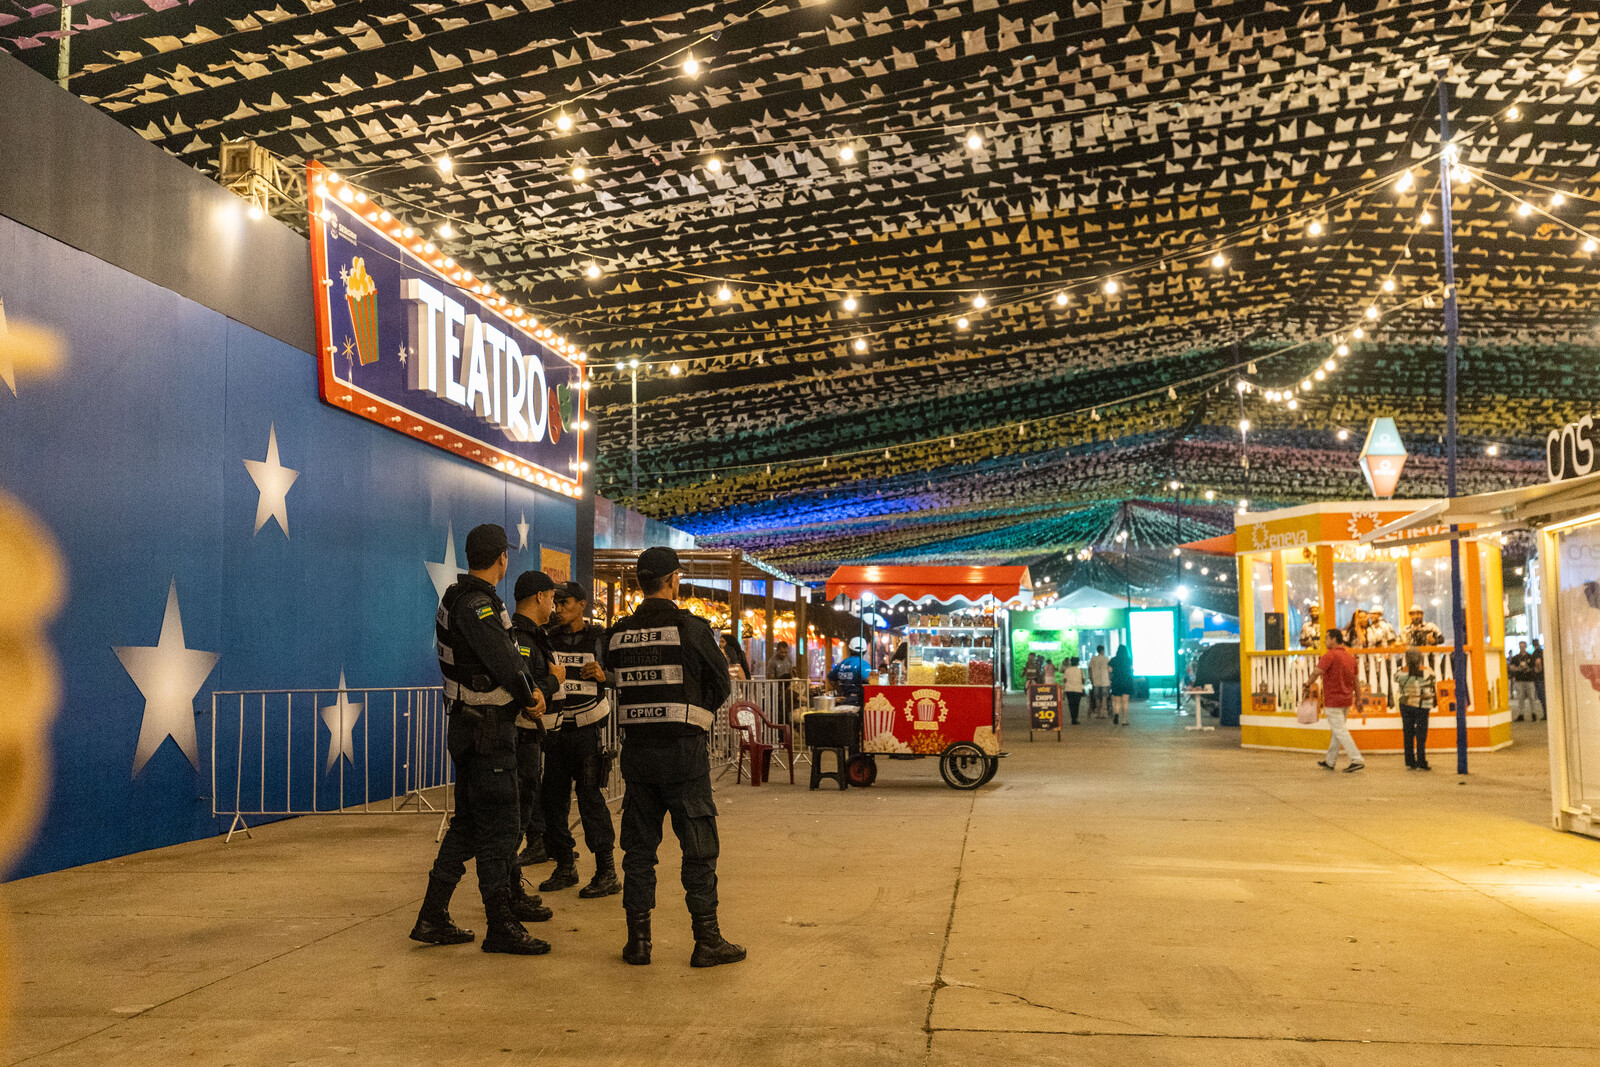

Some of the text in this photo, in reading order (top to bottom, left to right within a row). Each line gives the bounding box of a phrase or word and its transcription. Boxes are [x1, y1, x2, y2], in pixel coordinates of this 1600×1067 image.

[408, 278, 548, 442] TEATRO
[1269, 530, 1308, 549] eneva
[623, 632, 657, 643] PMSE
[630, 707, 663, 718] CPMC
